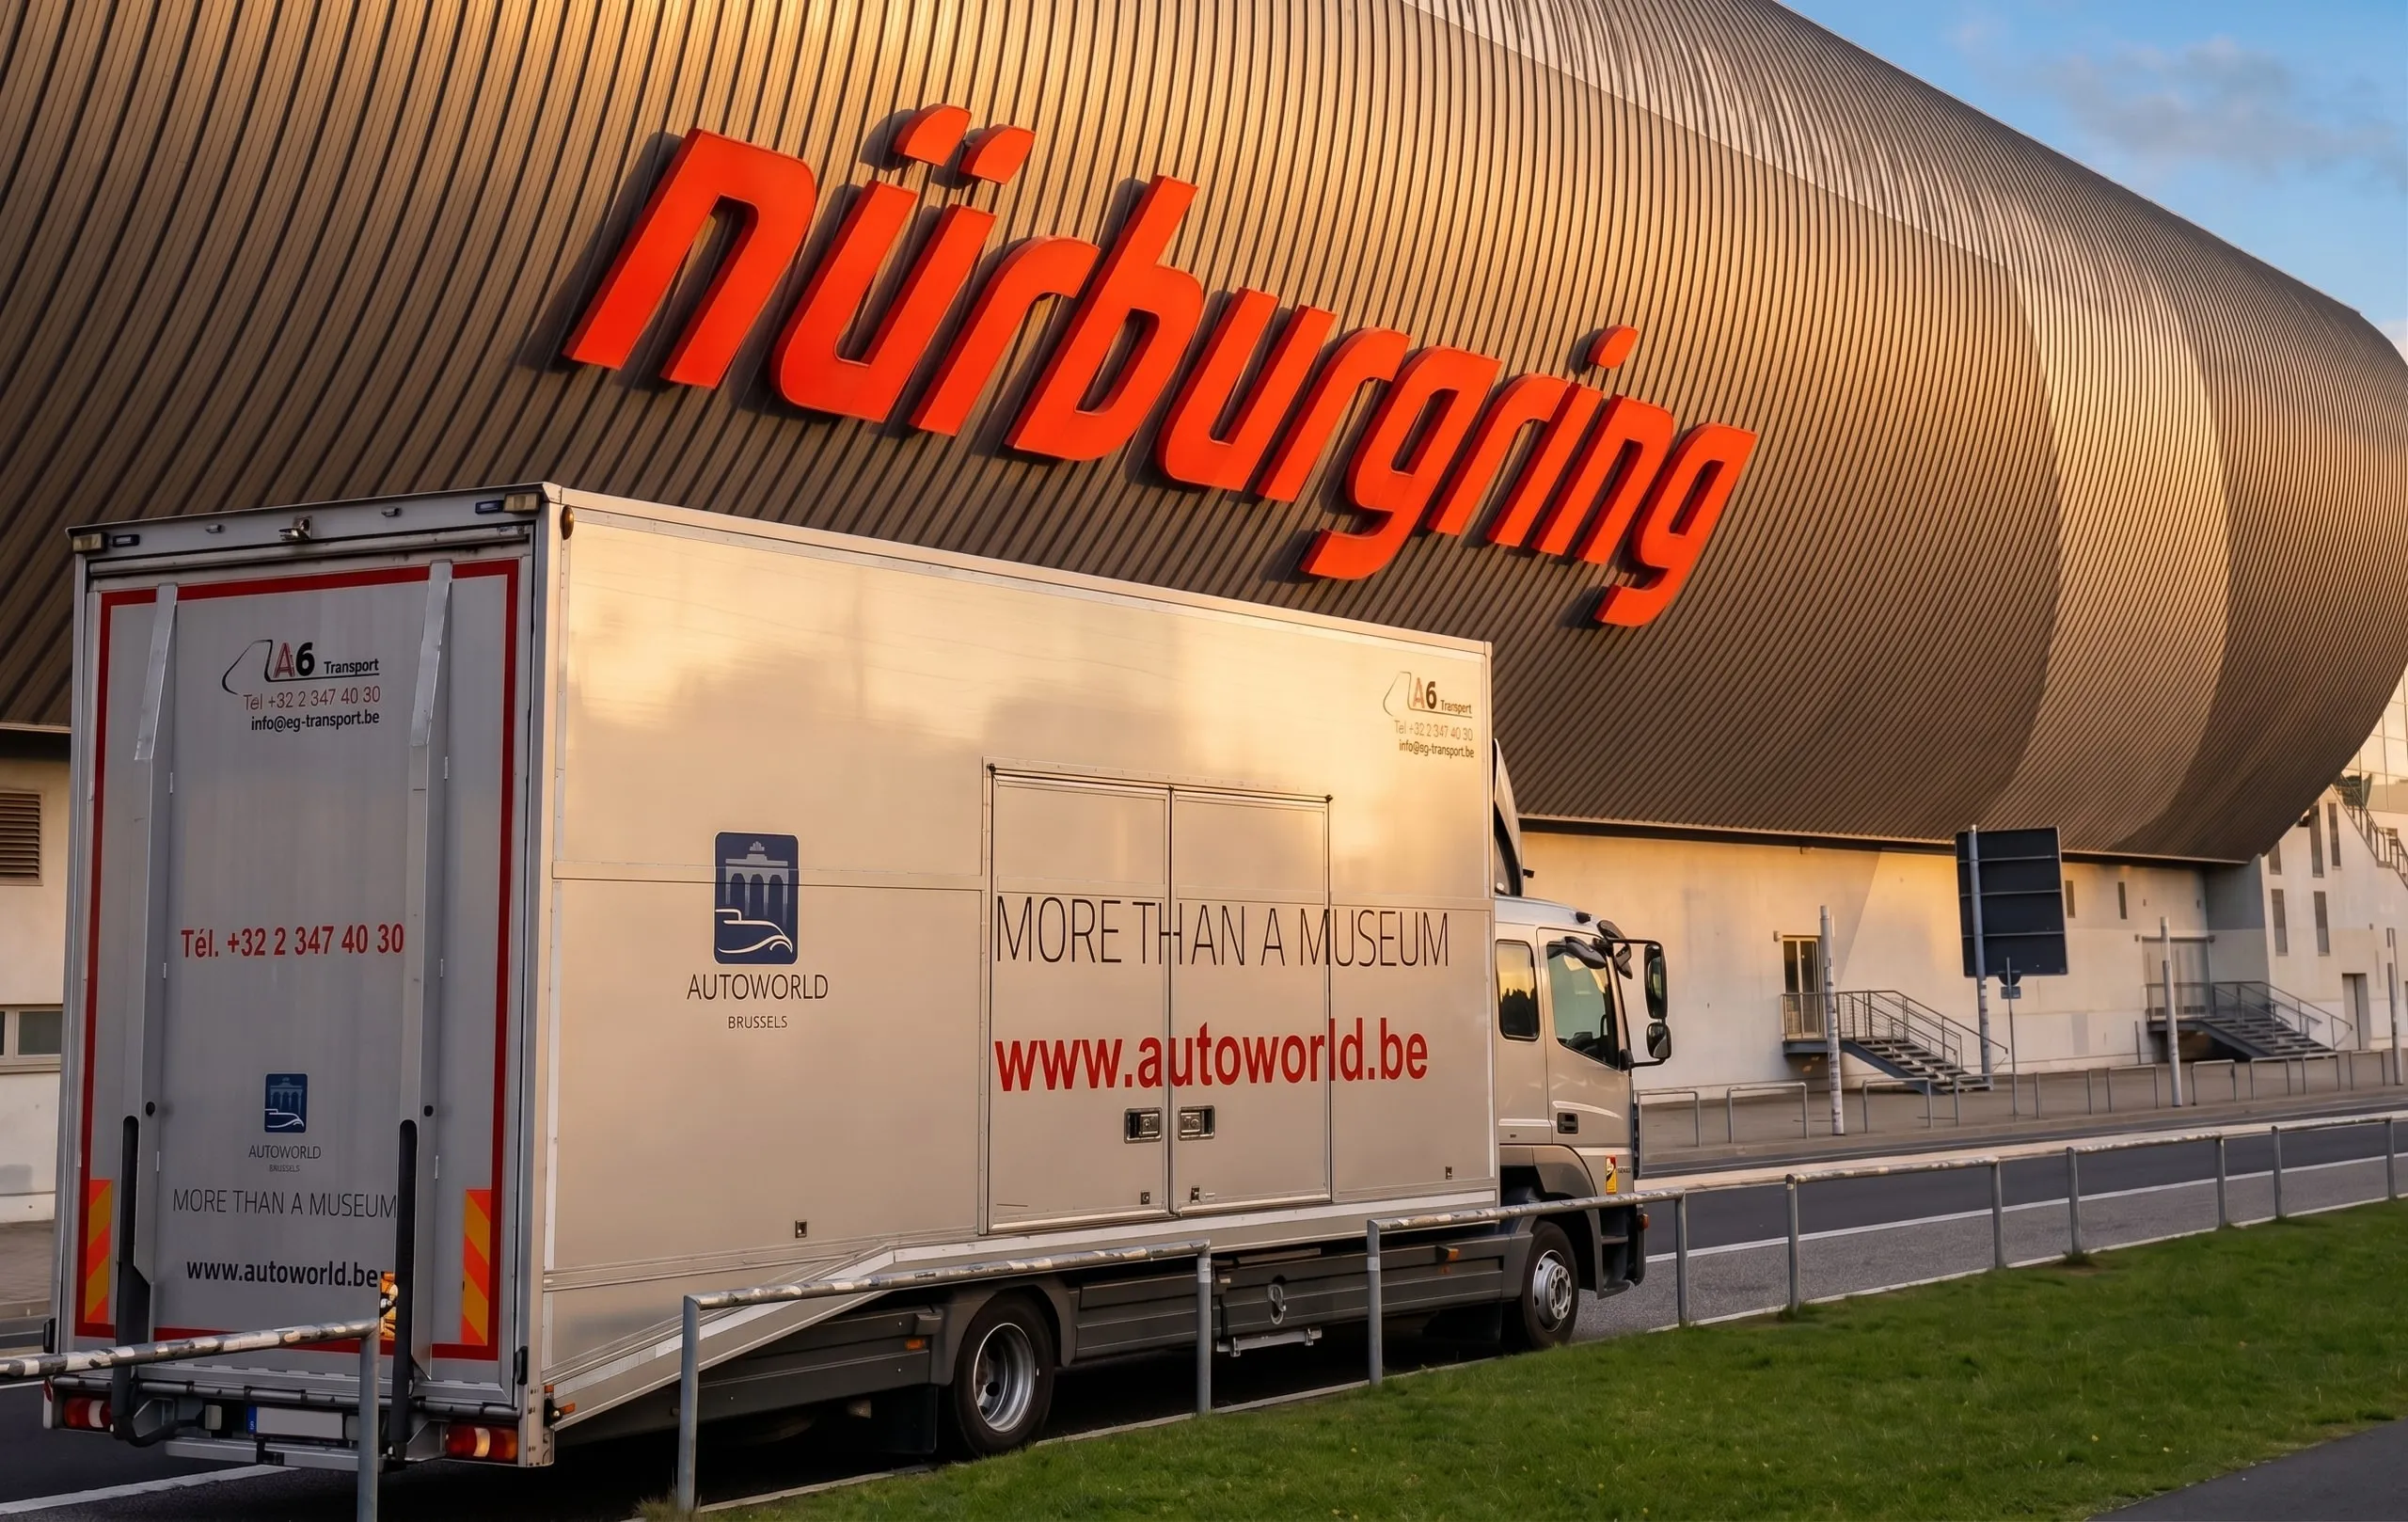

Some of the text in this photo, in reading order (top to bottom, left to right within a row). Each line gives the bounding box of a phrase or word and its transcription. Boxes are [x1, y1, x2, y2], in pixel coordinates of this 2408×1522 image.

[564, 103, 1757, 627] nürburgring
[324, 658, 379, 675] Transport
[243, 686, 381, 711] Tel +32 2 347 40 30
[1440, 700, 1472, 715] Transport
[1394, 720, 1474, 741] Tel +32 2 347 40 30
[181, 923, 404, 958] Tél. +32 2 347 40 30
[996, 896, 1450, 967] MORE THAN A MUSEUM
[687, 973, 829, 1001] AUTOWORLD
[728, 1015, 788, 1029] BRUSSELS
[994, 1017, 1429, 1092] www.autoworld.be
[248, 1145, 322, 1160] AUTOWORLD
[269, 1165, 301, 1173] BRUSSELS
[173, 1189, 397, 1218] MORE THAN A MUSEUM
[186, 1260, 378, 1288] www.autoworld.be
